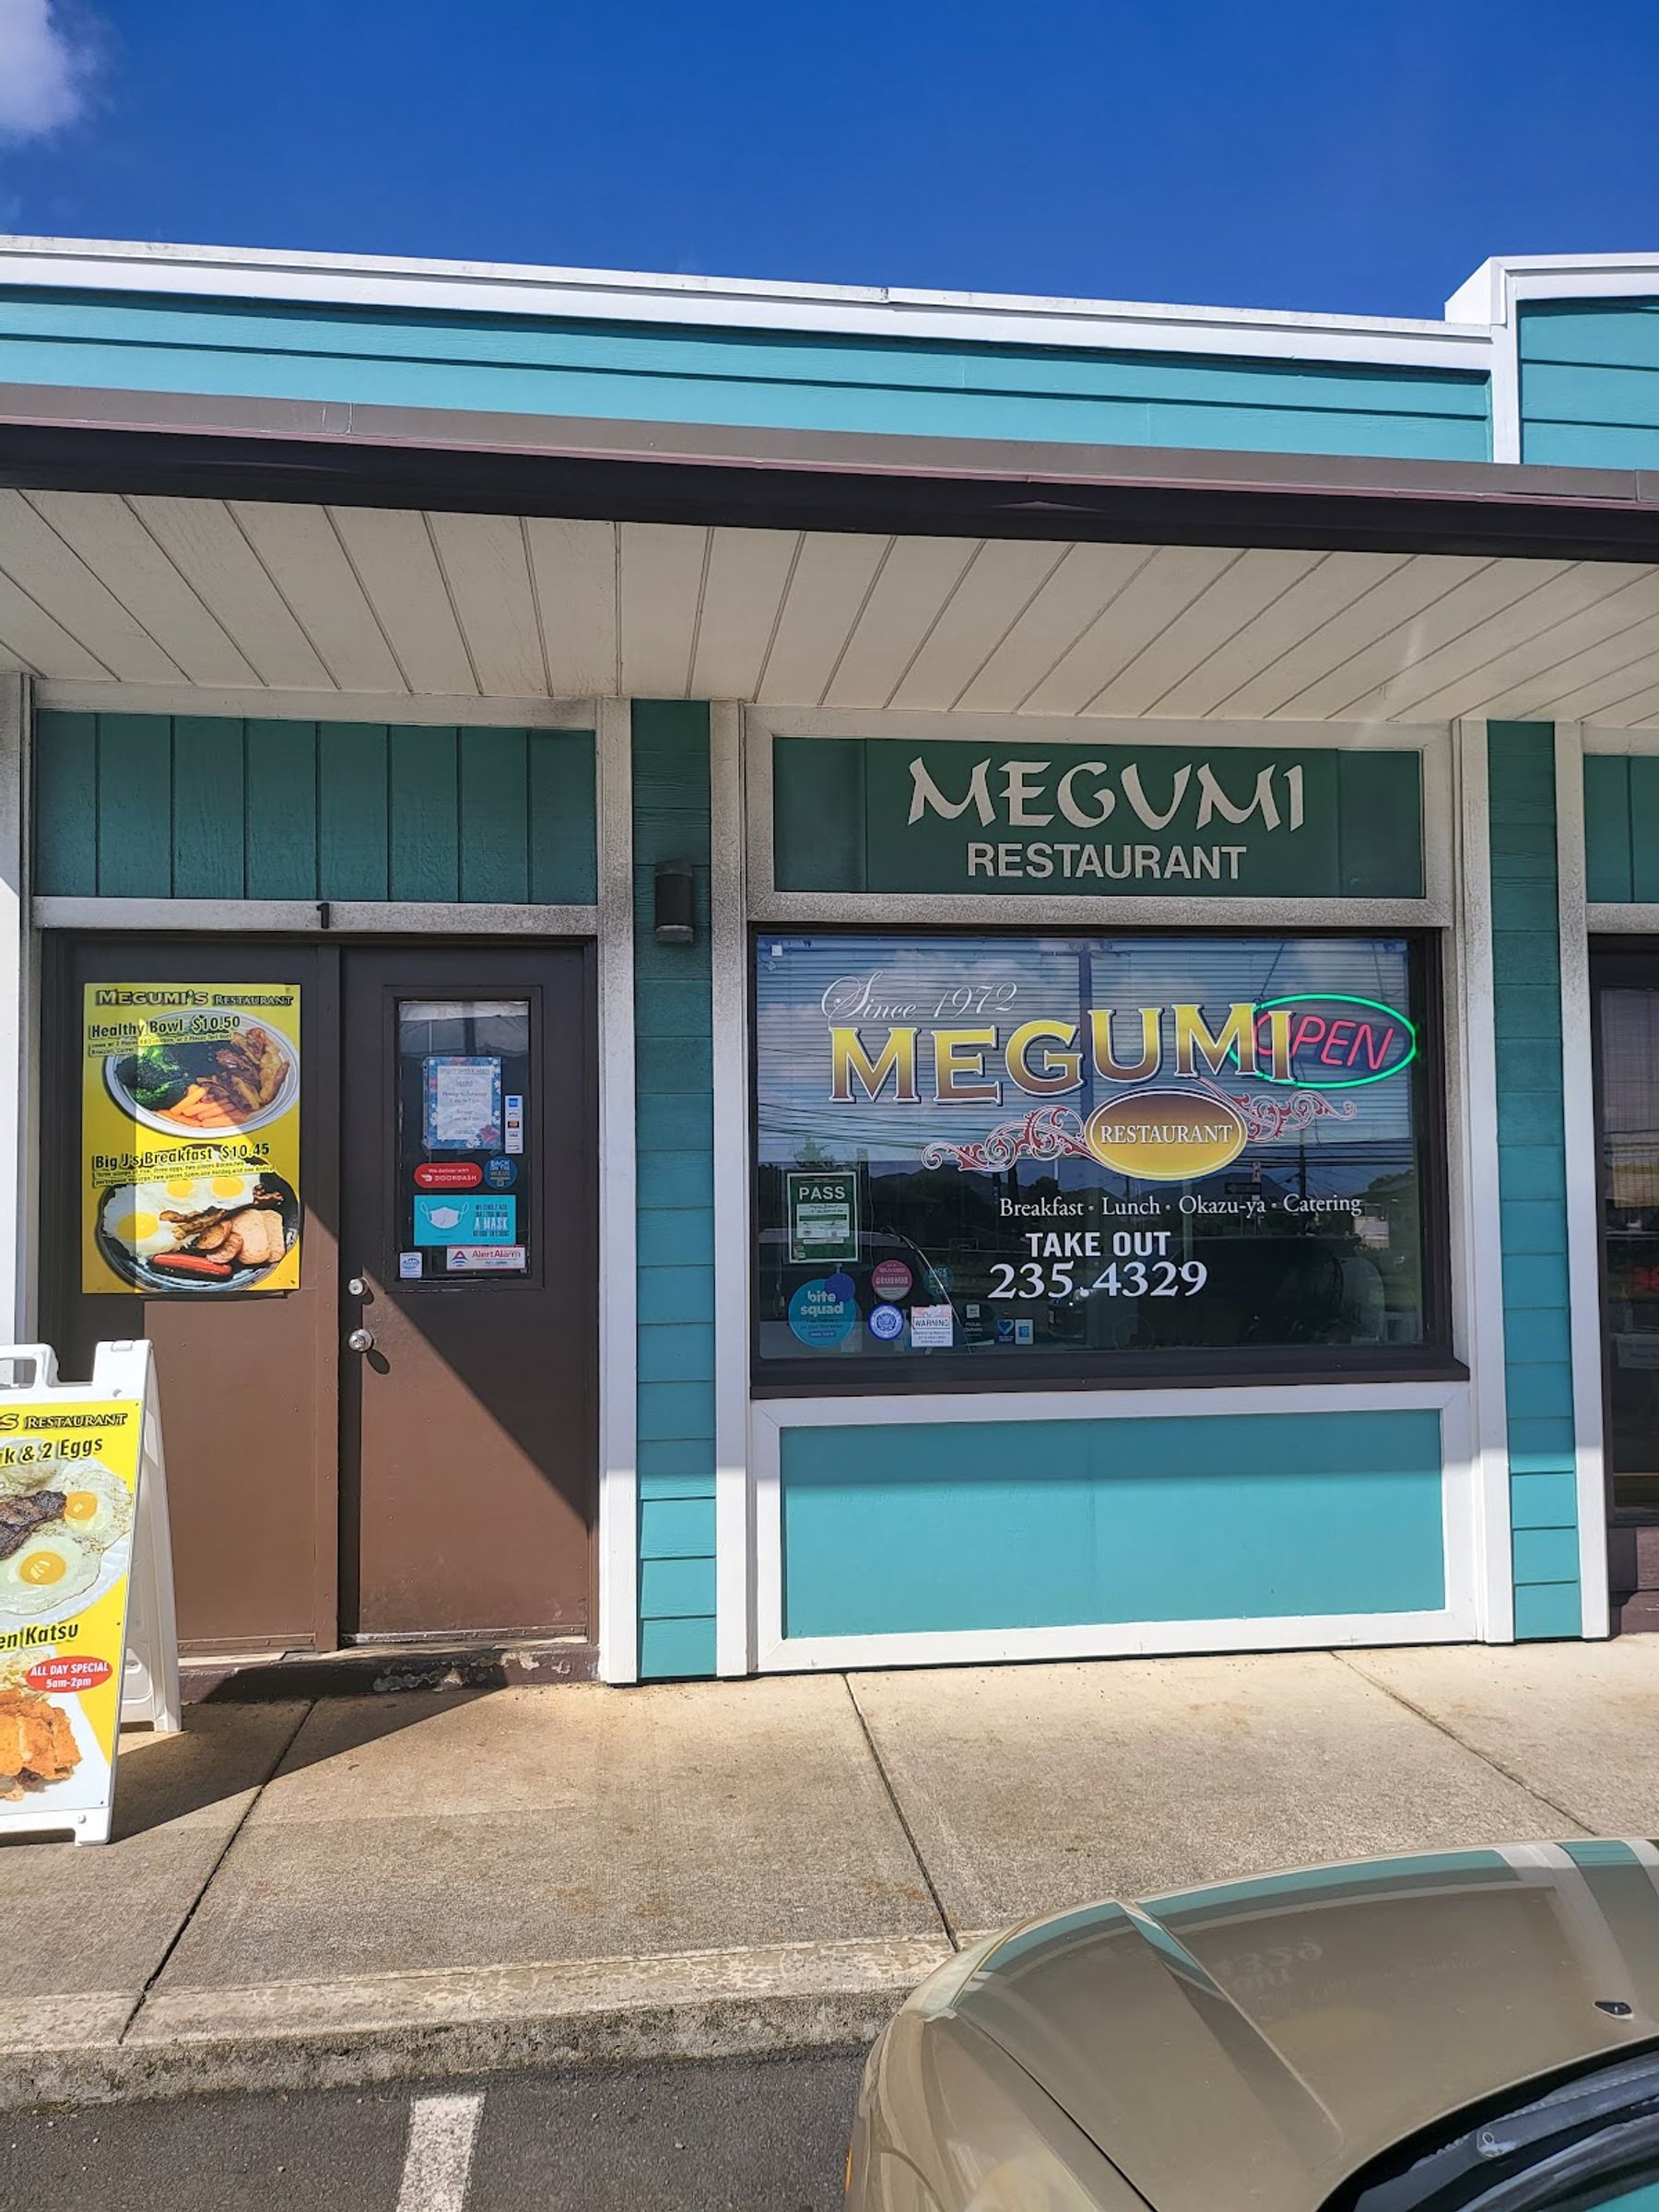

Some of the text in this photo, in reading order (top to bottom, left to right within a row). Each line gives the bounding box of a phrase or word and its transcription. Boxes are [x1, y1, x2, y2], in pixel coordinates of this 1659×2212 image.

[908, 757, 1305, 831] MEGUMI
[967, 842, 1247, 880] RESTAURANT
[96, 989, 293, 1006] MEGUMI'S RESTAURANT
[821, 971, 1018, 1019] Since 1972
[91, 1016, 241, 1039] Healthy Bowl $10.50
[830, 1003, 1296, 1105] MEGUMI
[1100, 1124, 1233, 1145] RESTAURANT
[96, 1155, 117, 1171] Big
[145, 1147, 212, 1165] Breakfast
[222, 1143, 270, 1159] $10.45
[799, 1186, 845, 1200] PASS
[1000, 1194, 1362, 1218] Breakfast Lunch Okazu-ya Catering
[475, 1217, 508, 1230] A MASK
[1026, 1231, 1171, 1257] TAKE OUT
[988, 1260, 1207, 1300] 235.4329
[807, 1290, 836, 1303] bite
[800, 1301, 844, 1318] squad
[915, 1319, 949, 1327] WARNING
[25, 1413, 128, 1430] RESTAURANT
[22, 1445, 35, 1462] &
[42, 1442, 53, 1459] 2
[60, 1439, 103, 1458] Eggs
[26, 1624, 78, 1645] Katsu
[30, 1662, 109, 1677] ALL DAY SPECIAL
[46, 1677, 91, 1688] 5am-2pm
